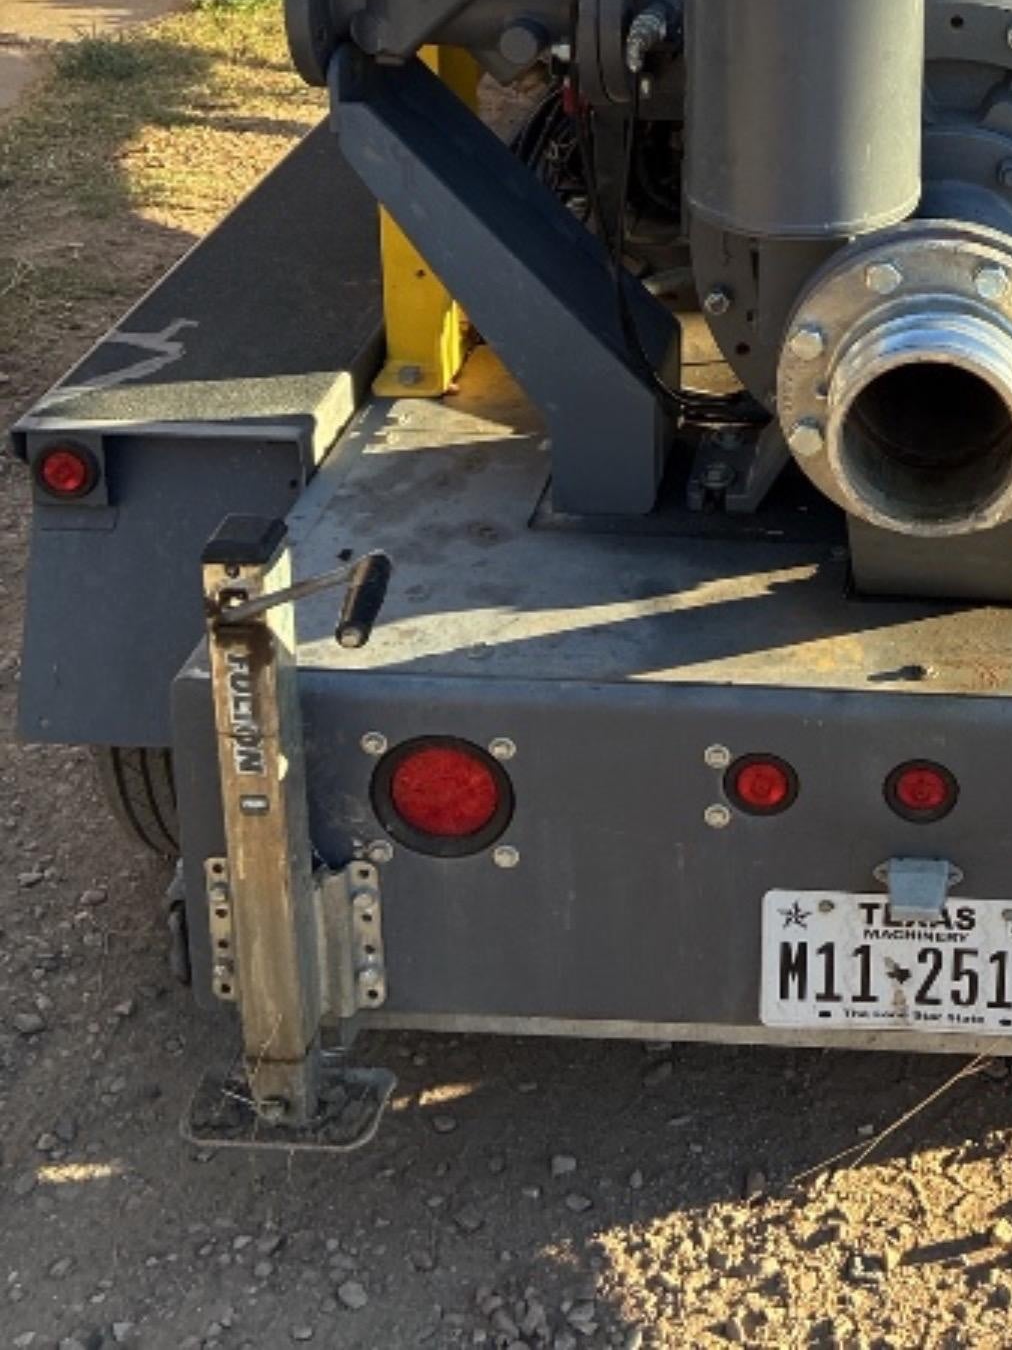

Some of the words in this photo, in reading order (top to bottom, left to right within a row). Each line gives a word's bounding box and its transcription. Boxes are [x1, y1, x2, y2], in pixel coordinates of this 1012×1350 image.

[225, 651, 266, 776] FULTON
[863, 929, 970, 943] MACHINERY
[779, 941, 879, 1003] M11
